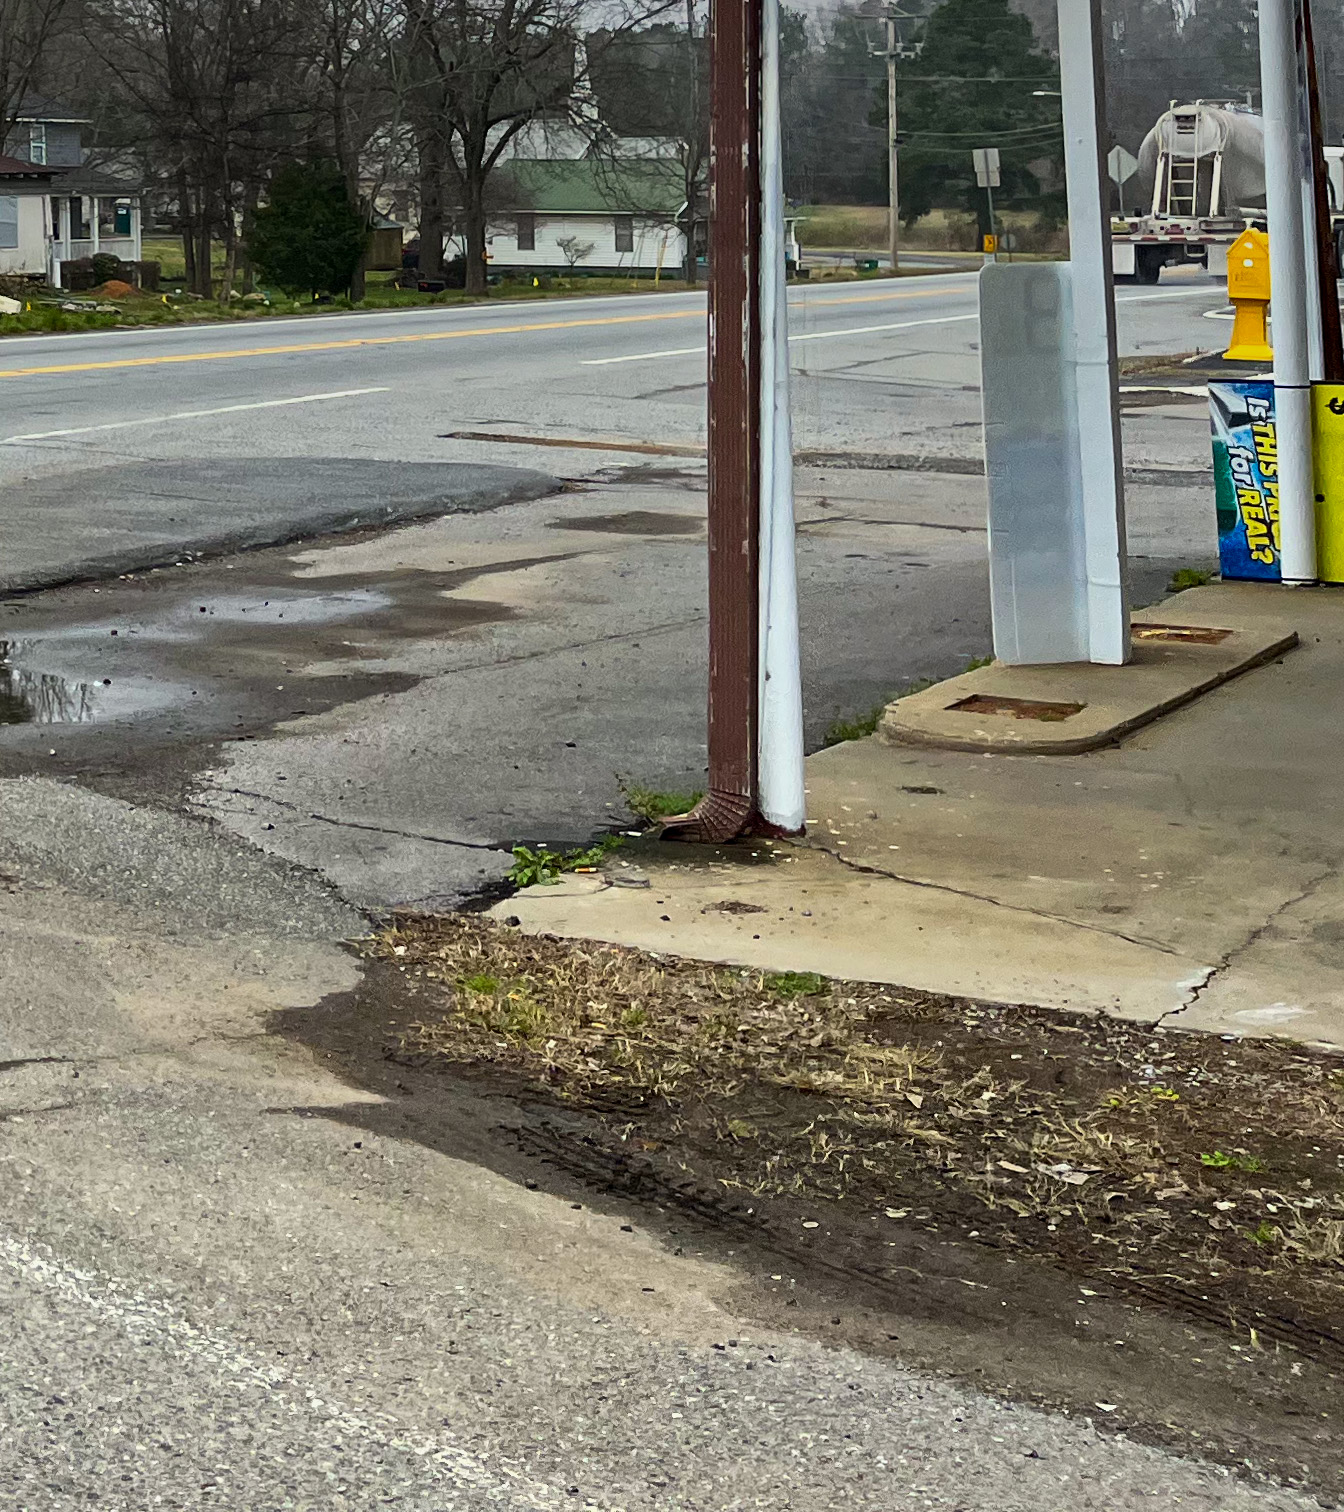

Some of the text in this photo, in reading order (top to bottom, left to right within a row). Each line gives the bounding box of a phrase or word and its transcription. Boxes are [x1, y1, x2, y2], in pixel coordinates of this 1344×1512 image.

[1246, 396, 1270, 420] Is
[1252, 422, 1278, 478] THIS
[1227, 446, 1274, 565] for REAL?
